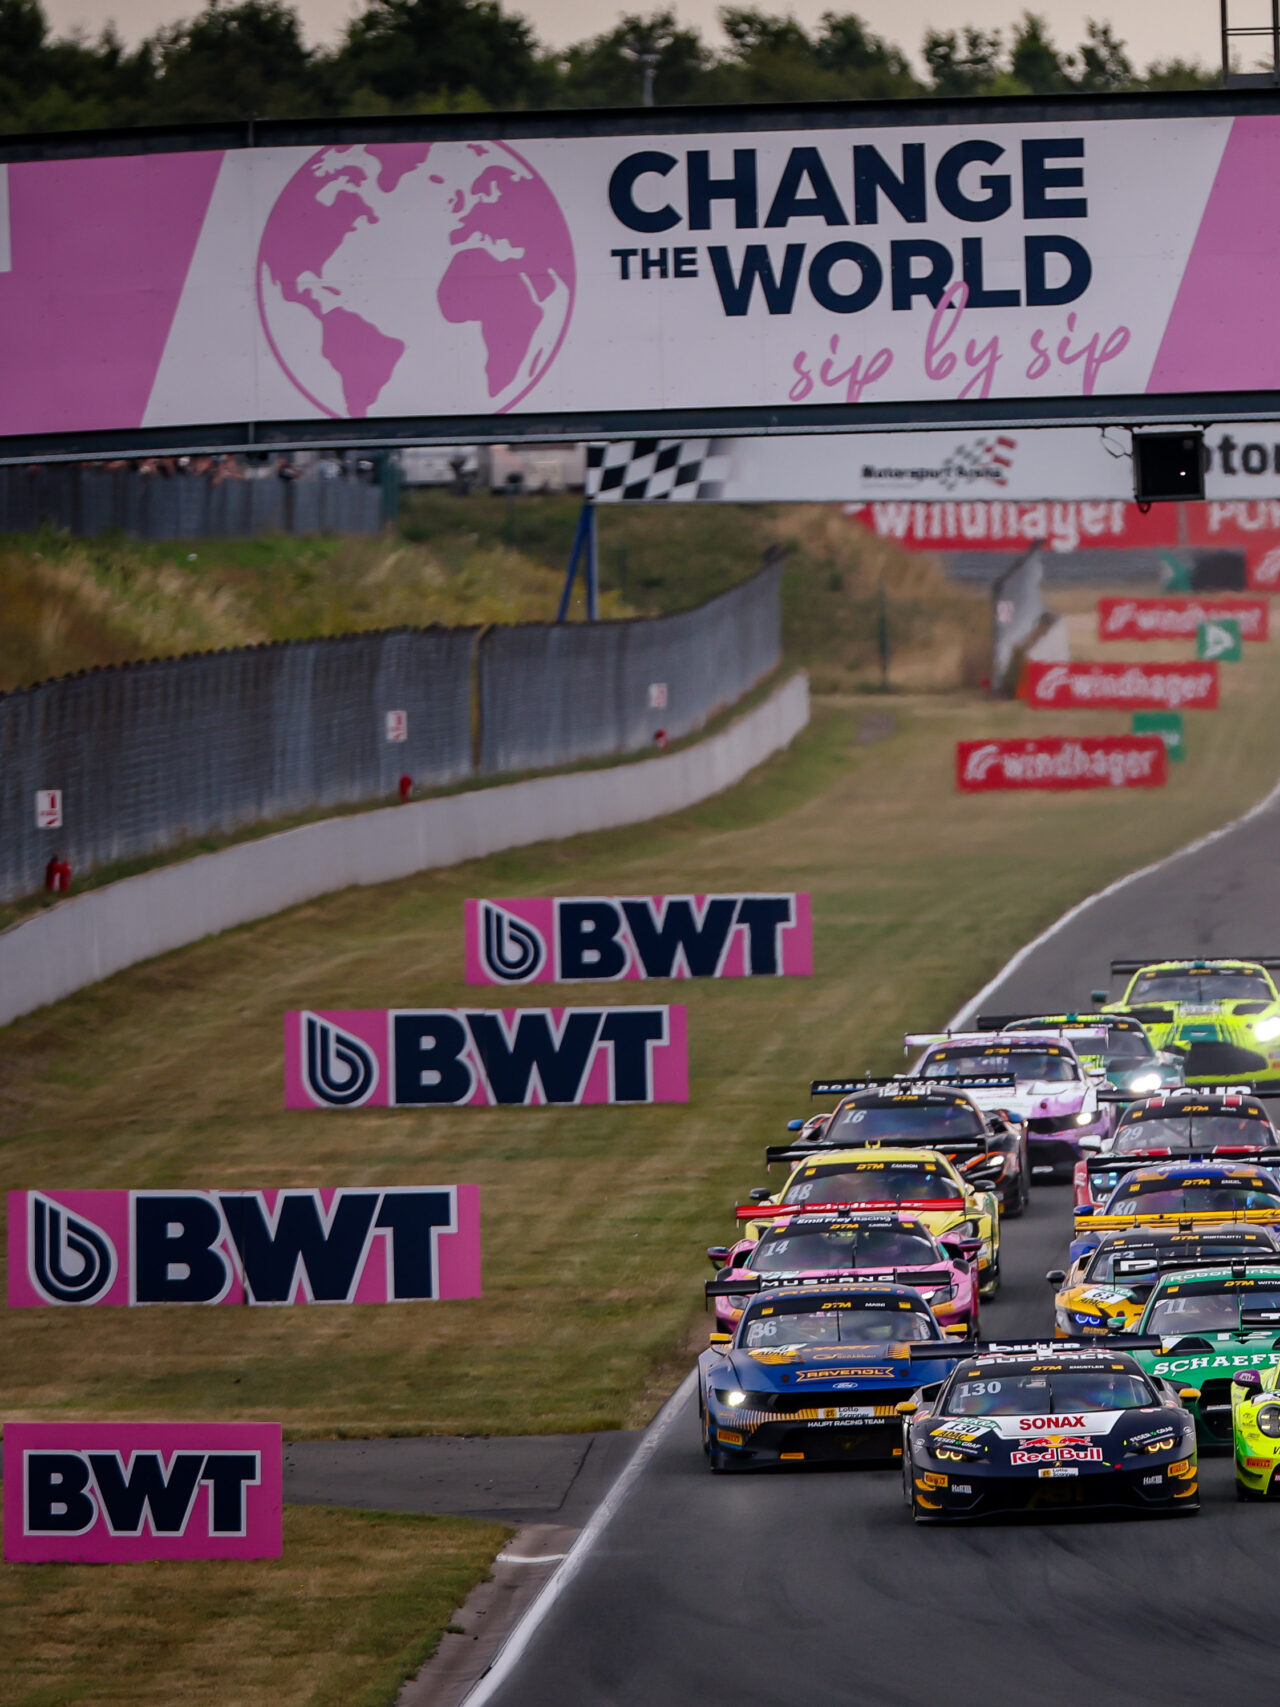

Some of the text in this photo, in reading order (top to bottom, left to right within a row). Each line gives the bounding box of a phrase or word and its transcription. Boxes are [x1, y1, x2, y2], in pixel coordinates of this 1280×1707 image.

[608, 137, 1088, 233] CHANGE
[611, 234, 1092, 316] THE WORLD
[788, 280, 1131, 403] sip by sip
[553, 893, 797, 981] BWT
[387, 1005, 670, 1107] BWT
[842, 1110, 868, 1124] 16
[1119, 1126, 1144, 1140] 29
[1181, 1178, 1211, 1186] DTM
[796, 1217, 823, 1225] Emil
[129, 1184, 458, 1307] BWT
[763, 1239, 790, 1258] 14
[761, 1274, 895, 1287] MUSTANG
[1092, 1290, 1115, 1300] 63
[821, 1301, 852, 1309] DTM
[1164, 1299, 1186, 1315] 11
[1153, 1352, 1280, 1377] SCHAEFF
[807, 1368, 884, 1378] RAVENOL
[959, 1381, 1002, 1398] 130
[833, 1419, 863, 1427] RACING
[864, 1418, 886, 1426] TEAM
[946, 1422, 981, 1434] 130
[1019, 1415, 1086, 1431] SONAX
[937, 1430, 969, 1441] ADAC
[961, 1441, 982, 1449] GRAF
[1010, 1447, 1104, 1466] Red Bull
[22, 1449, 262, 1537] BWT
